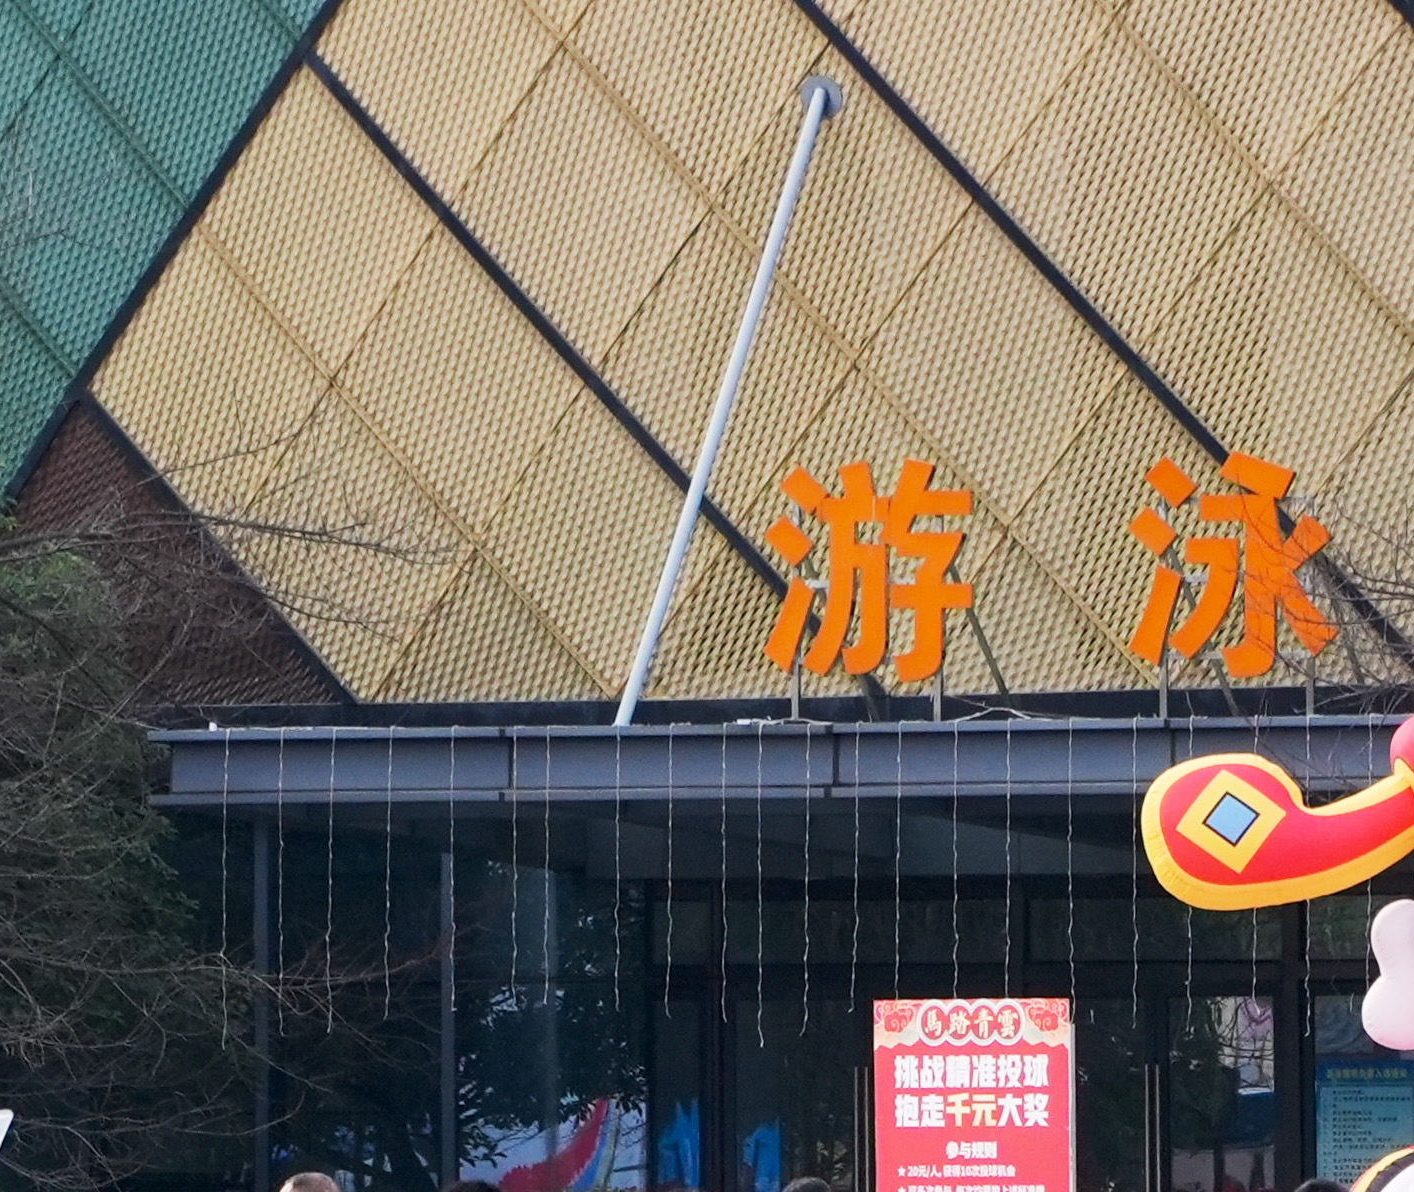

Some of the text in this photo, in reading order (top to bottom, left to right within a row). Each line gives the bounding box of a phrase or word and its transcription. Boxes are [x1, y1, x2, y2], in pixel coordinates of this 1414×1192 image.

[924, 1008, 1019, 1040] 馬踏青雲
[893, 1054, 1049, 1089] 挑战精准投球
[894, 1093, 1050, 1127] 抱走千元大奖
[945, 1141, 998, 1160] 参与规则
